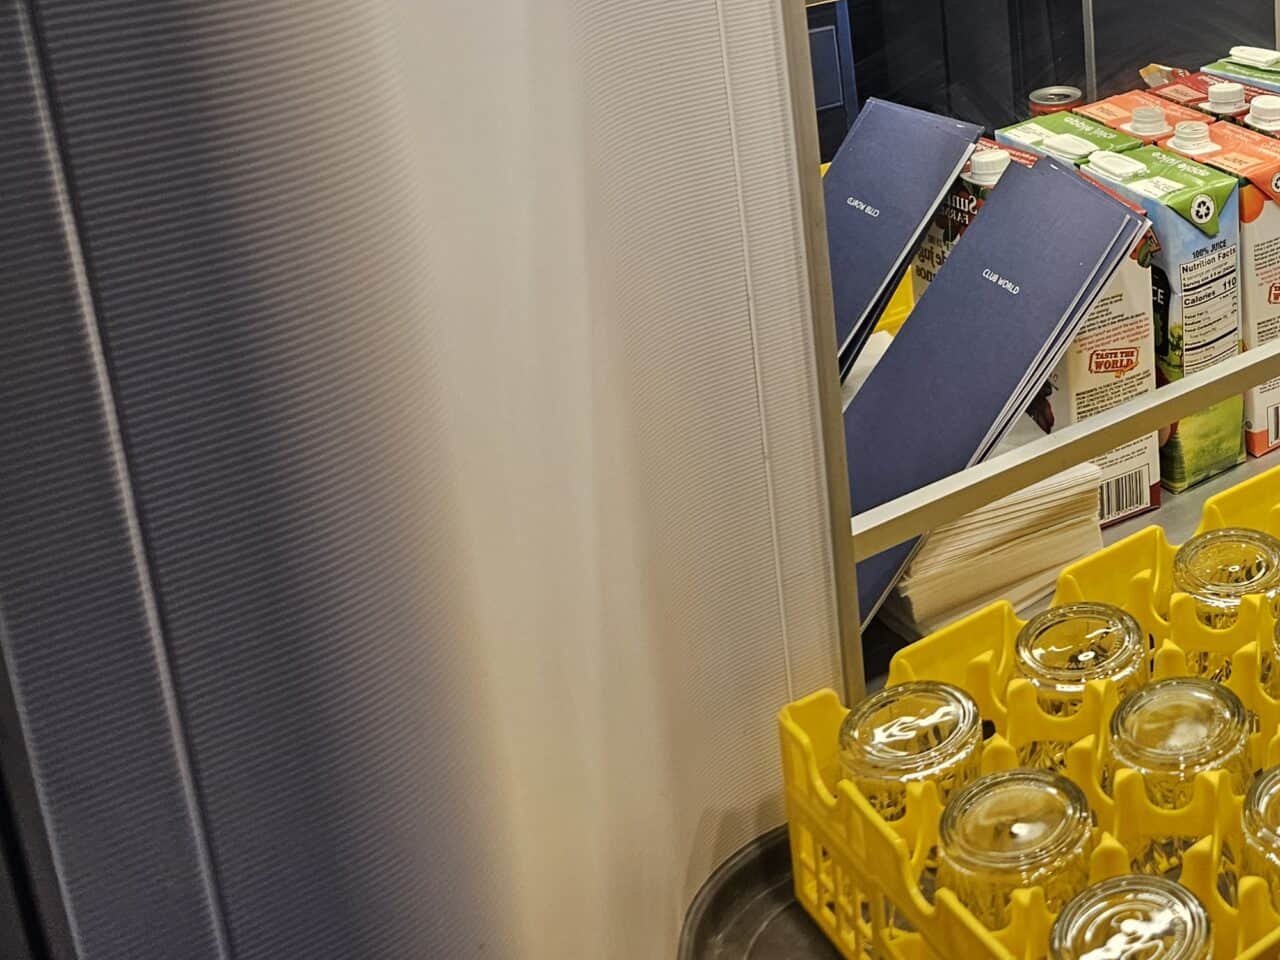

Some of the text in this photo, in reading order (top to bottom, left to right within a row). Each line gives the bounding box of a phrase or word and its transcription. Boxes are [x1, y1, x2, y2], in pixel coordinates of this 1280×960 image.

[1210, 239, 1226, 253] JUICE
[1182, 247, 1236, 274] Nutrition Facts
[982, 268, 1020, 295] CLUB WORLD
[1223, 276, 1237, 290] 110
[1183, 290, 1216, 306] Calories
[1095, 350, 1135, 360] TASTE THE
[1094, 359, 1134, 371] WORLD
